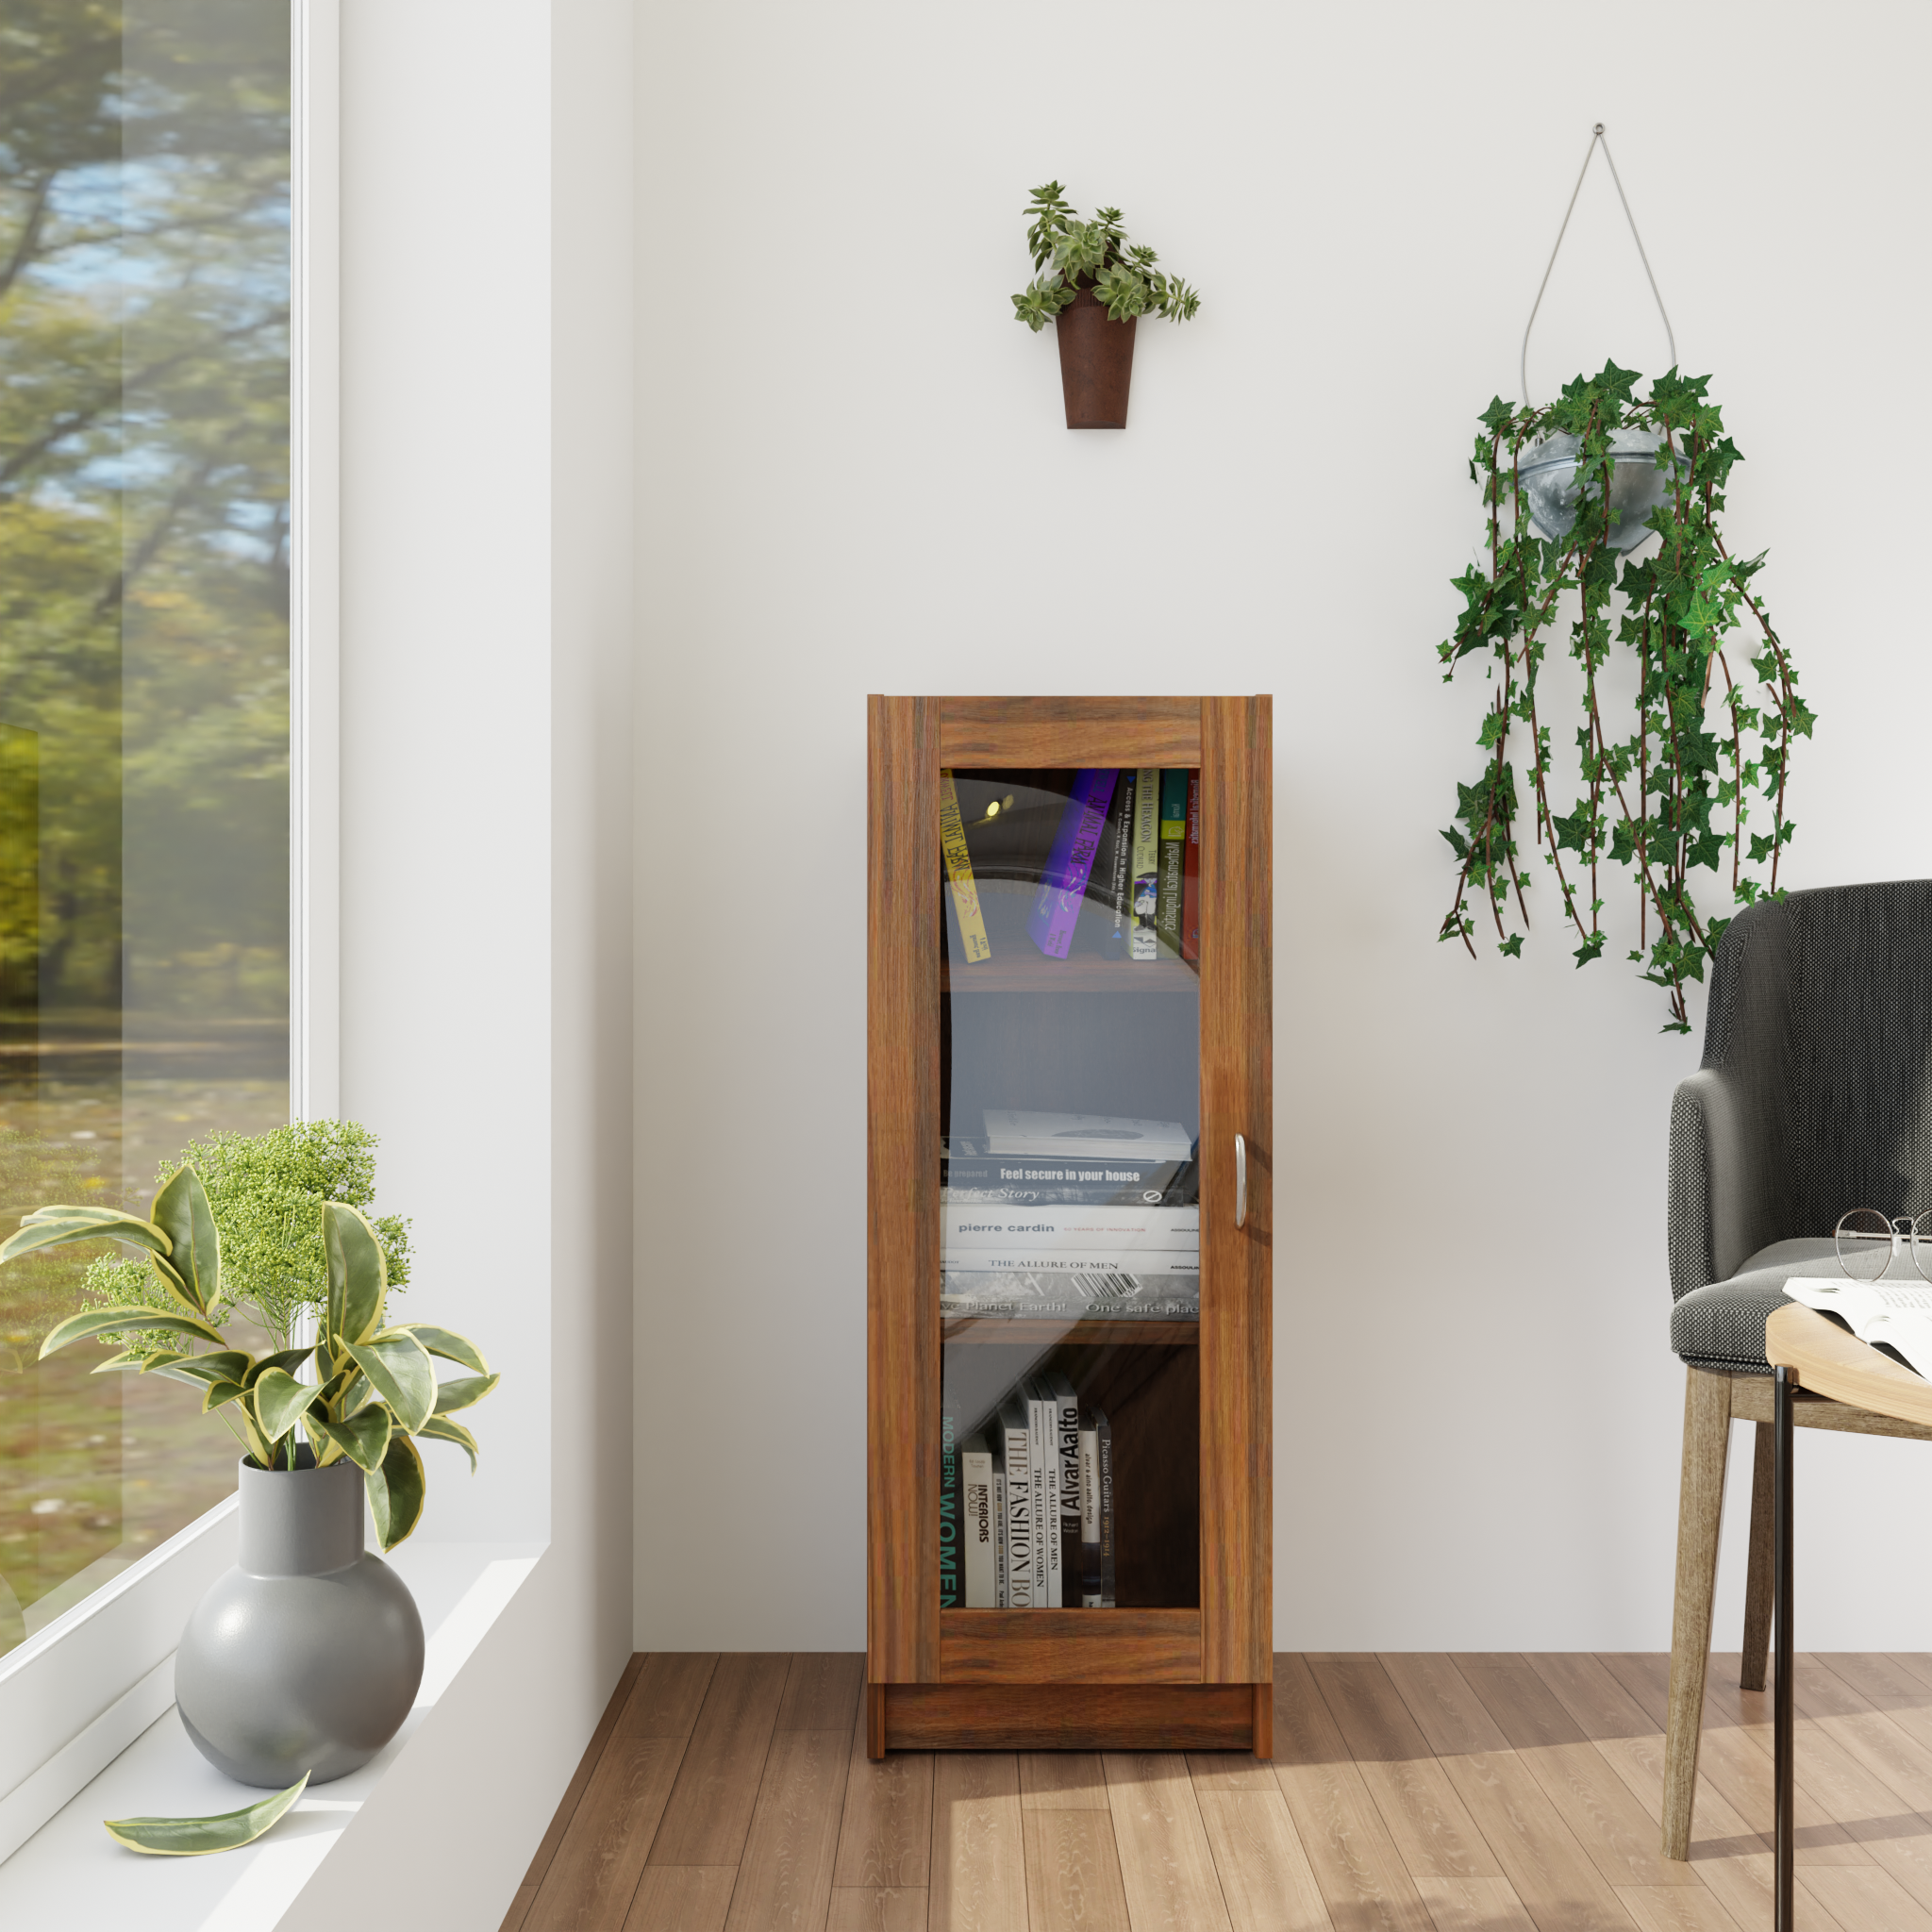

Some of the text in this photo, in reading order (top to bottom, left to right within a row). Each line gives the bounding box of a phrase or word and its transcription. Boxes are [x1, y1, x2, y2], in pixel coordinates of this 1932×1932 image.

[1092, 769, 1110, 792] RWELL
[1141, 784, 1153, 800] THE
[1124, 787, 1134, 812] Access
[1070, 794, 1108, 865] ANIMAL FARM
[1141, 802, 1154, 842] HEXAGON
[1120, 821, 1131, 857] Expansion
[1148, 850, 1157, 865] TERRY
[1116, 867, 1126, 891] Higher
[1114, 892, 1124, 928] Education
[1000, 1168, 1141, 1182] Feel secure in your house
[941, 1187, 993, 1200] Perfect
[998, 1187, 1040, 1202] Story
[958, 1224, 1055, 1233] pierre cardin
[989, 1259, 1119, 1271] THE ALLURE OF MEN
[966, 1302, 1015, 1312] Planet
[1020, 1302, 1067, 1312] Earth!
[1086, 1303, 1199, 1315] One safe plac
[1058, 1407, 1080, 1511] Alvar Aalto
[1102, 1439, 1111, 1474] Picasso
[967, 1484, 978, 1517] NOW!
[1103, 1475, 1112, 1513] Guitars
[941, 1416, 957, 1607] MODERN WOMEN
[978, 1484, 990, 1543] INTERIORS
[1008, 1432, 1031, 1607] THE FASHION BO
[1035, 1491, 1043, 1530] ALLURE
[1036, 1531, 1043, 1545] OF
[1050, 1531, 1058, 1546] OF
[1036, 1547, 1044, 1588] WOMEN
[1050, 1547, 1058, 1571] MEN
